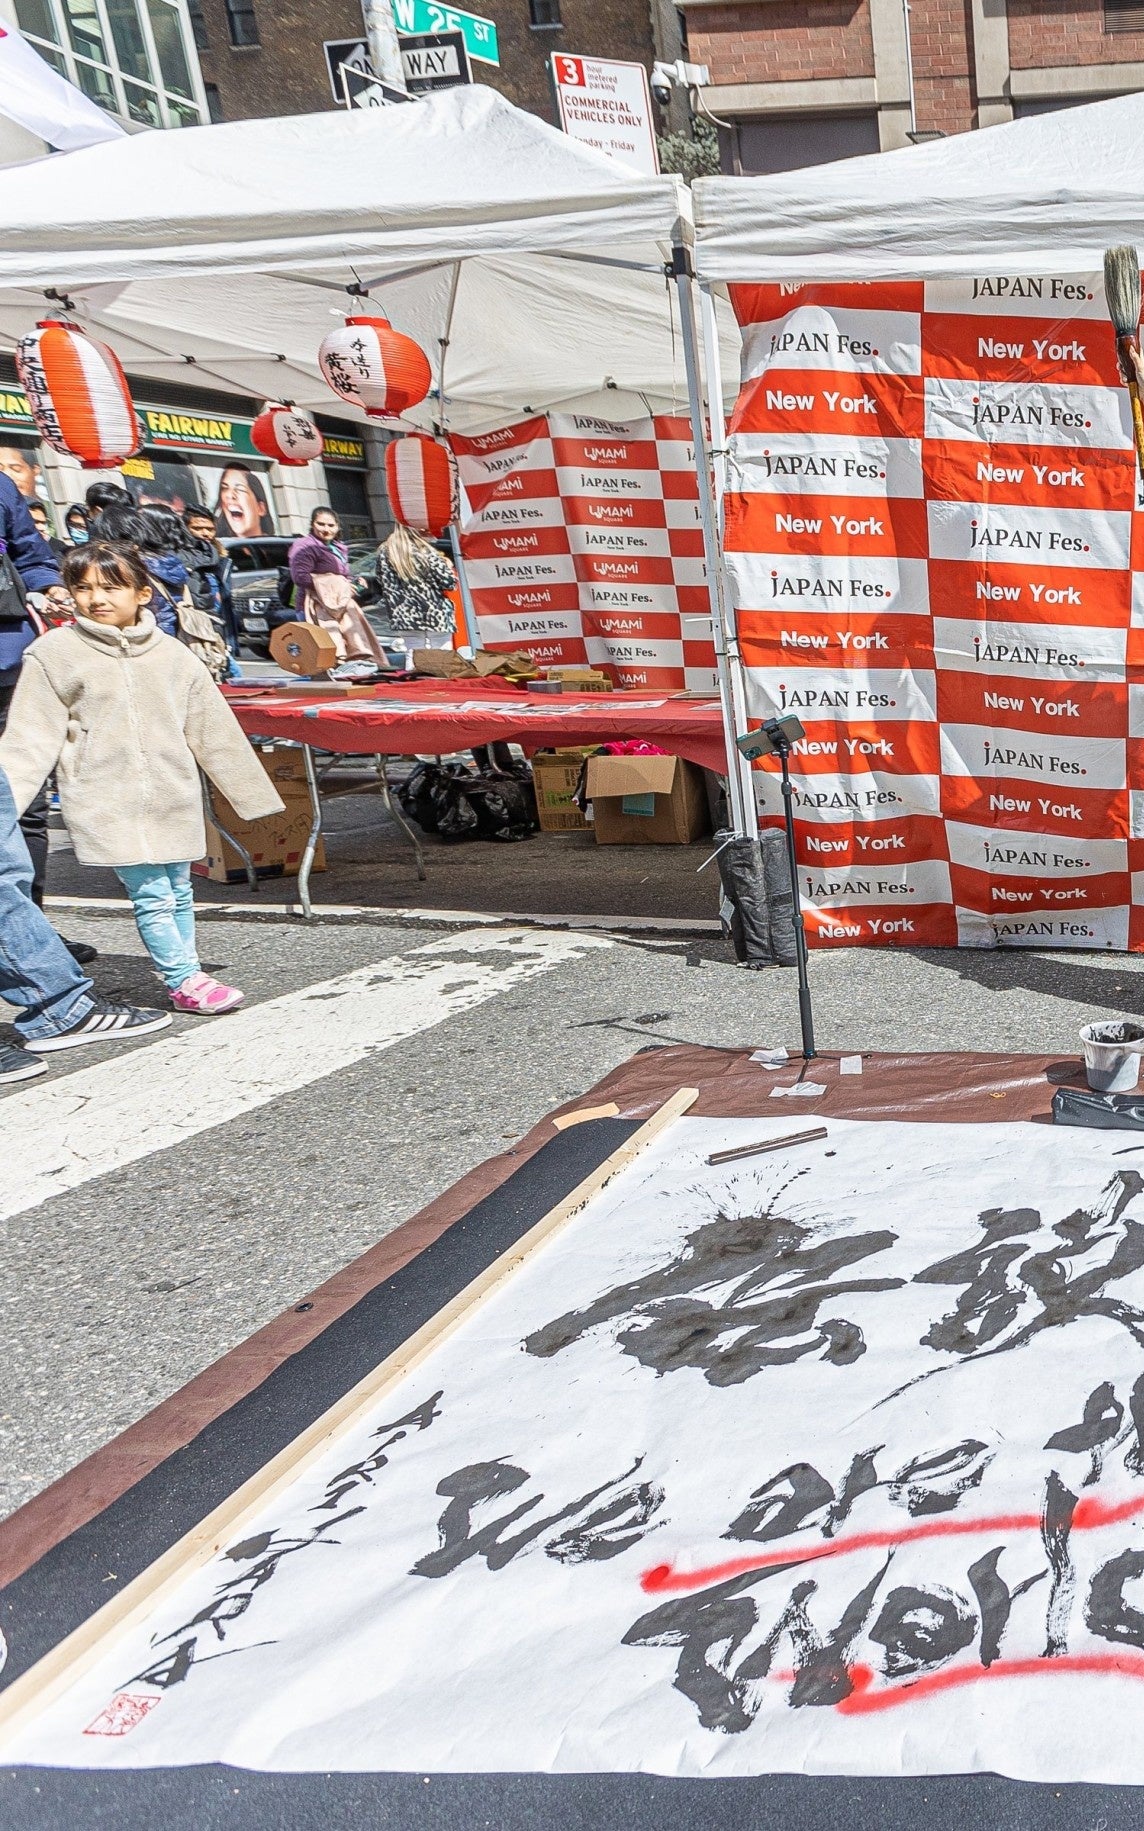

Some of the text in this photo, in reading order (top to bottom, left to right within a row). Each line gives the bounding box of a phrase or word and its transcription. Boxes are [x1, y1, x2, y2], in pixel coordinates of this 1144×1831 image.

[396, 0, 415, 31] W
[474, 22, 490, 42] ST
[406, 50, 447, 75] WAY
[562, 58, 579, 84] 3
[565, 95, 631, 112] COMMERCIAL
[567, 109, 642, 127] VEHICLES ONLY
[611, 140, 635, 152] Friday
[978, 338, 1086, 362] New York
[766, 390, 877, 414] New York
[146, 411, 232, 440] FAIRWAY
[324, 439, 362, 457] IRWAY
[976, 462, 1085, 488] New York
[775, 514, 884, 536] New York
[780, 631, 889, 650] New York
[983, 692, 1080, 718] New York
[806, 834, 905, 853] New York
[992, 887, 1087, 902] New York
[818, 918, 914, 940] New York
[718, 1438, 996, 1543] are
